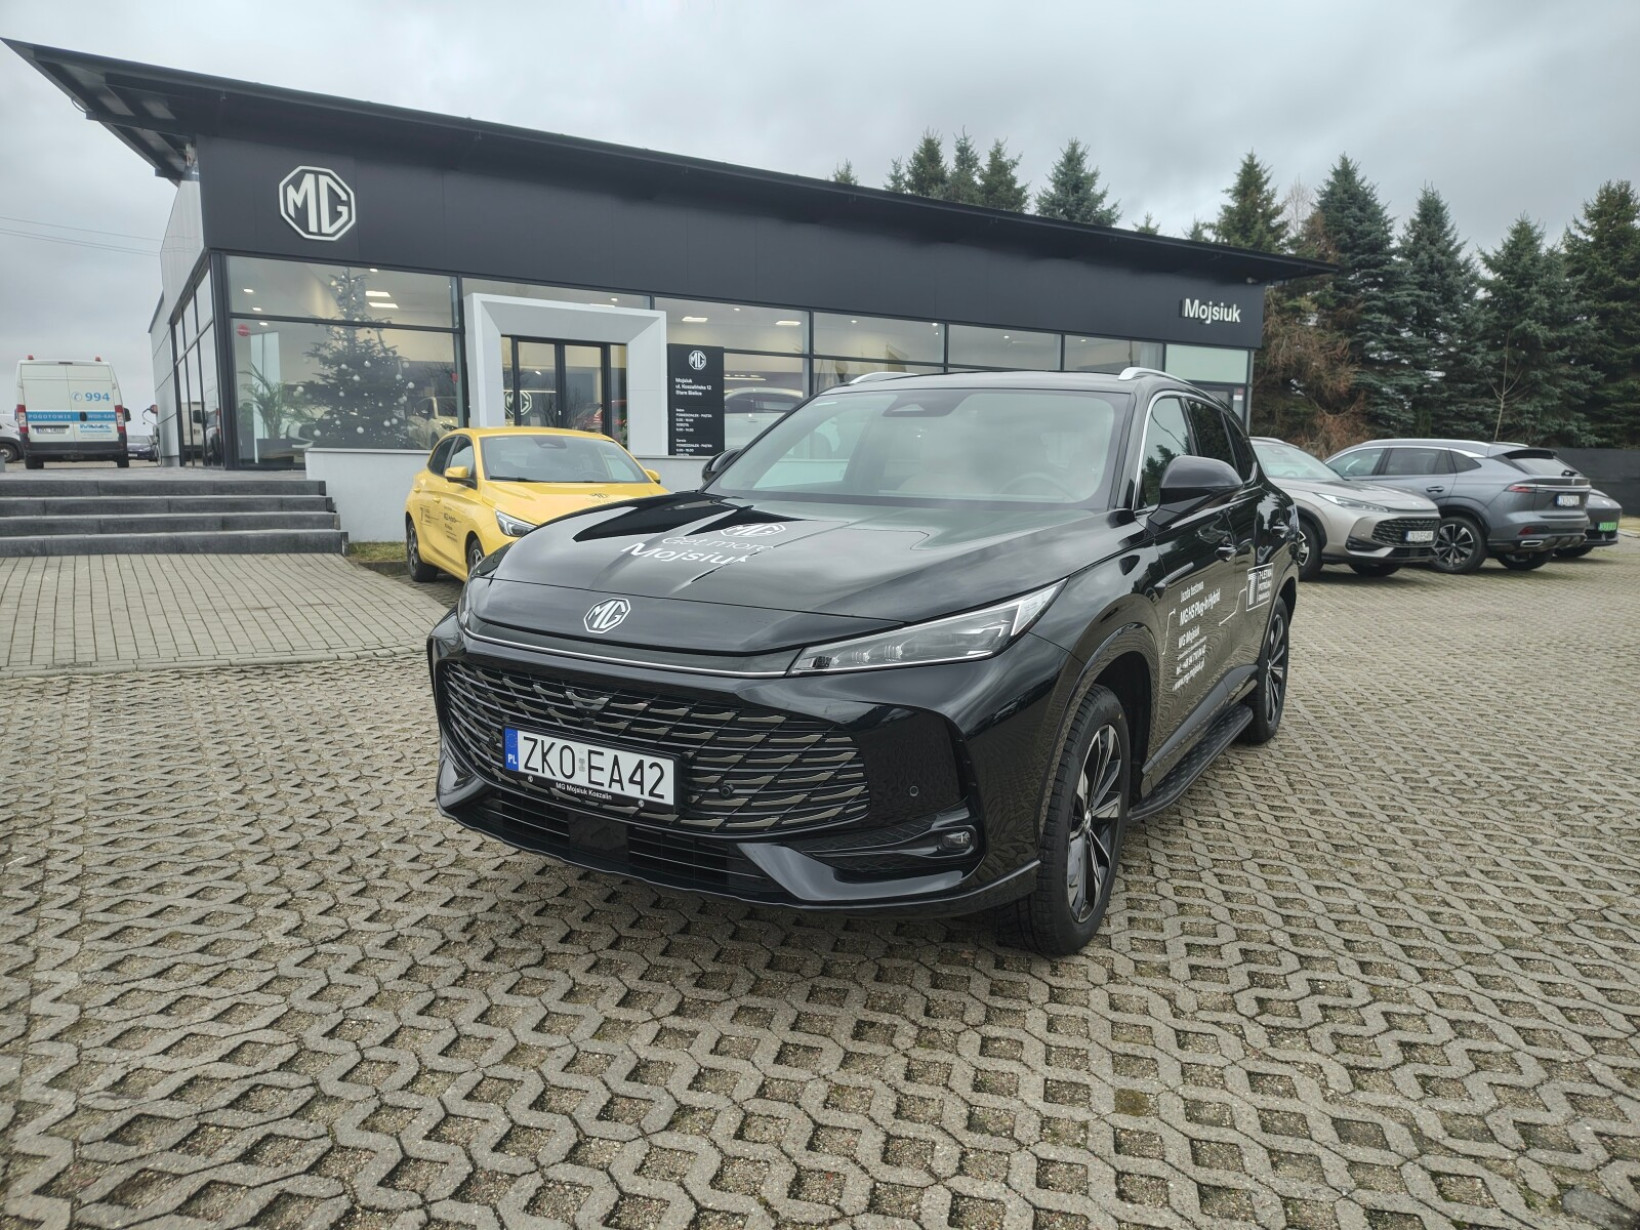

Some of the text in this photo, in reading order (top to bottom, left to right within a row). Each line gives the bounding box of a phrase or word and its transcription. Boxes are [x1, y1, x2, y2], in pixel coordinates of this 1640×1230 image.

[283, 170, 352, 237] MG
[1184, 298, 1241, 324] Mojsiuk
[690, 351, 705, 369] MG
[85, 392, 110, 402] 994
[724, 523, 782, 537] MG
[662, 536, 708, 546] Get
[621, 542, 749, 564] Mojsiuk
[586, 599, 629, 631] MG
[507, 753, 517, 765] PL
[523, 736, 664, 799] ZKO EA42
[555, 782, 612, 800] MG Mojsiuk Koszalin
